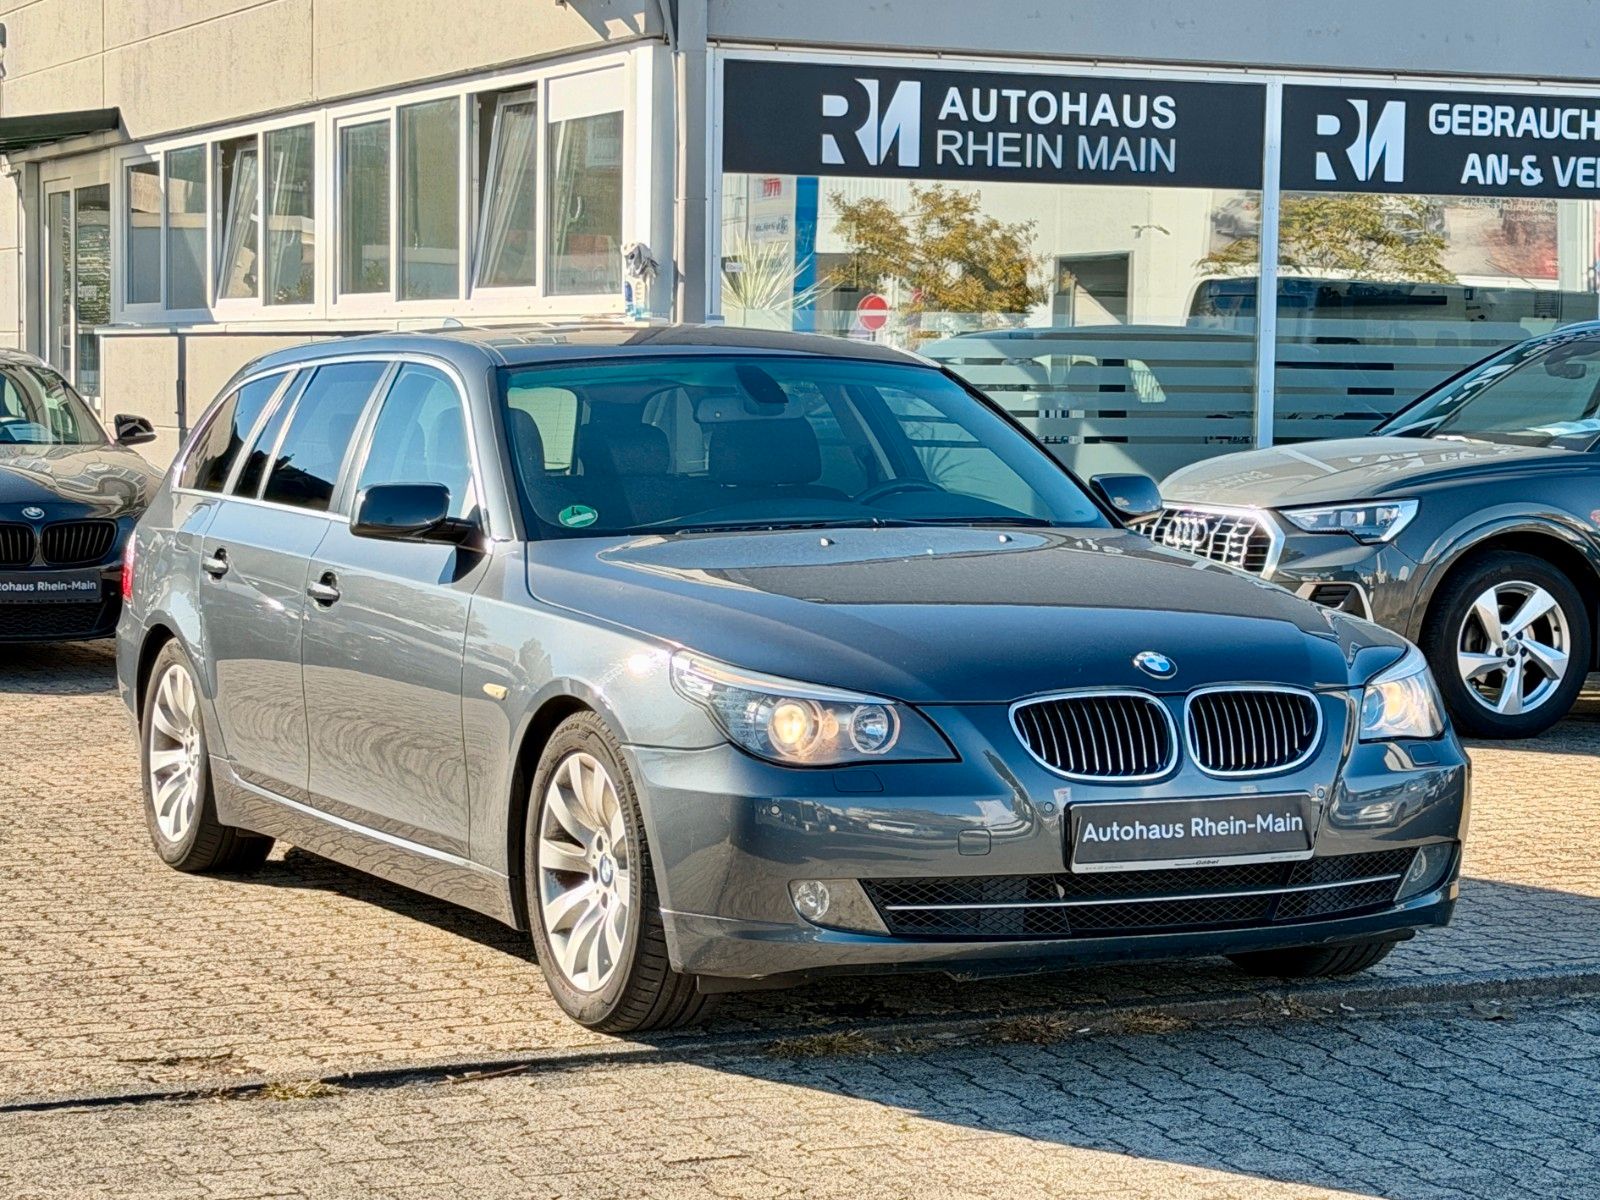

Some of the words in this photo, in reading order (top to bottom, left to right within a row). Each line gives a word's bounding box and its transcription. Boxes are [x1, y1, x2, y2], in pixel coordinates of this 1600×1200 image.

[938, 86, 1177, 129] AUTOHAUS
[1428, 103, 1600, 140] GEBRAUCH
[936, 130, 1062, 168] RHEIN
[1076, 134, 1177, 174] MAIN
[1459, 152, 1544, 187] AN-&
[1551, 155, 1600, 189] VE
[37, 580, 96, 591] Rhein-Main
[1082, 821, 1185, 843] Autohaus
[1190, 813, 1303, 837] Rhein-Main
